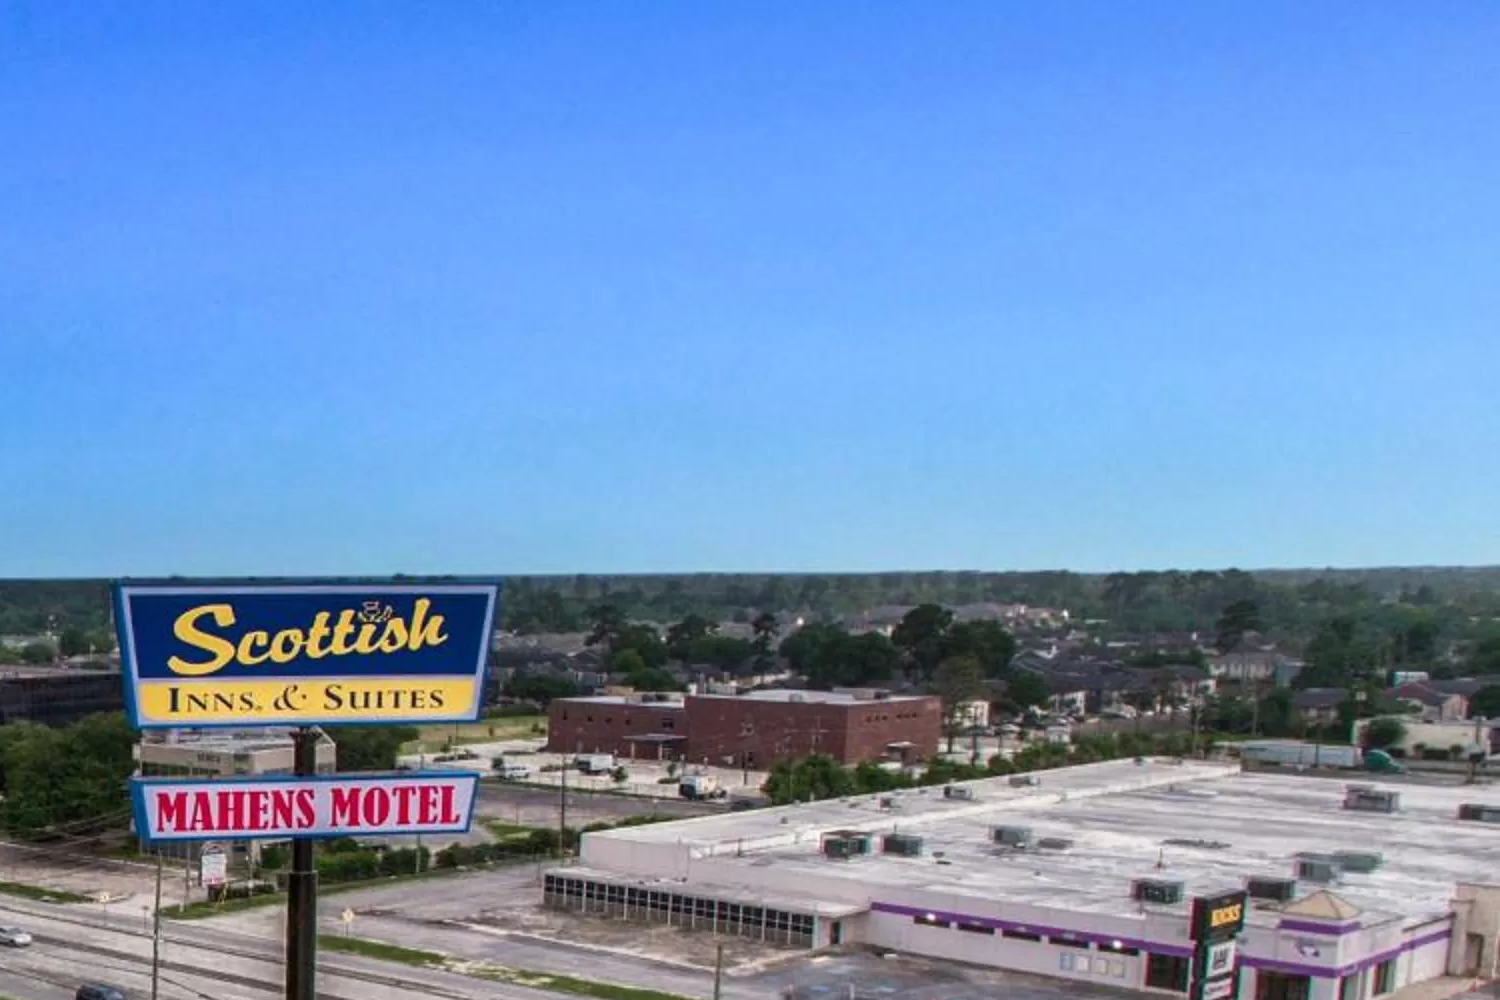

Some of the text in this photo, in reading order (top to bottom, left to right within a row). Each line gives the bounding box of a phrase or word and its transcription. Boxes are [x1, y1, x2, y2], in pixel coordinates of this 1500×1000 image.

[167, 598, 448, 676] Scottish
[273, 684, 307, 711] &
[156, 785, 460, 832] MAHENS MOTEL
